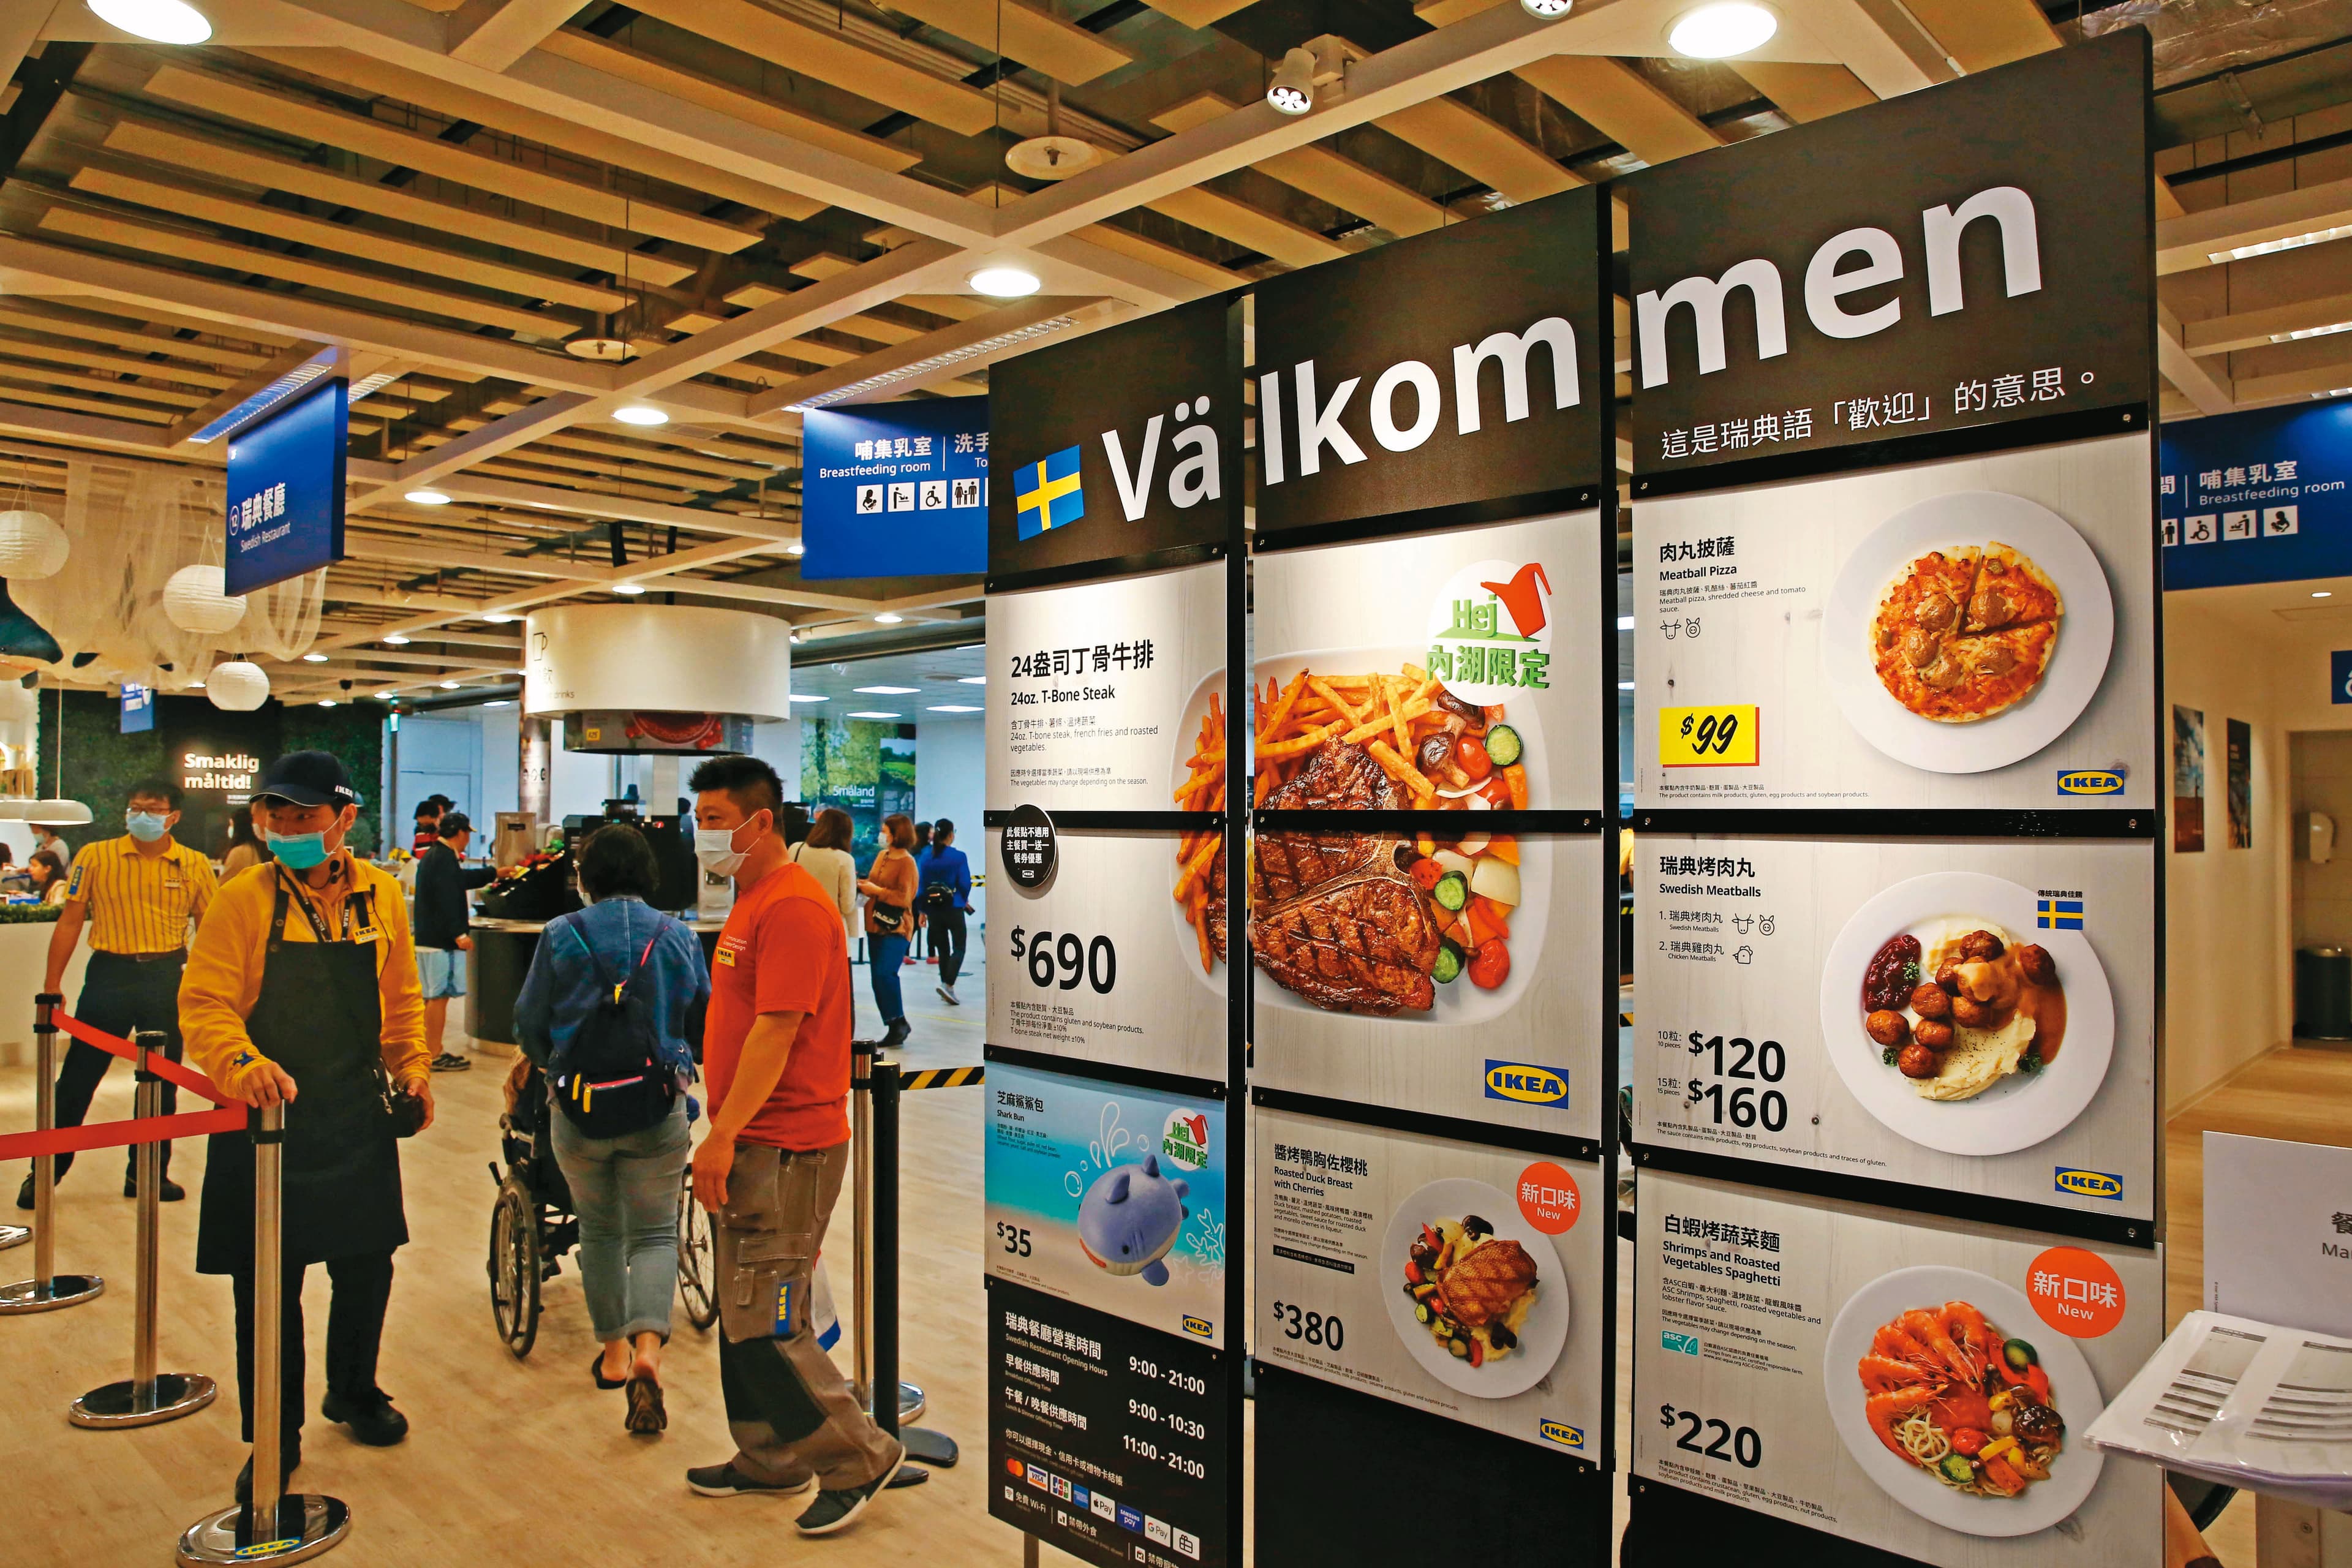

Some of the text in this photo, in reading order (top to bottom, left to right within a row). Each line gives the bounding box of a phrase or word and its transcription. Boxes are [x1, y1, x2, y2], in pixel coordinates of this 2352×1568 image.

[855, 436, 932, 461] 哺集乳室
[820, 462, 930, 478] Breastfeeding room
[975, 458, 987, 468] To
[2200, 461, 2297, 489] 哺集乳室
[2200, 481, 2344, 505] Breastfeeding room
[241, 482, 286, 531] 瑞典餐廳
[241, 522, 290, 552] Swedish Restaurant
[1660, 536, 1735, 563] 肉丸披薩
[1660, 565, 1736, 581] Meatball Pizza
[1659, 596, 1686, 605] Meatball
[1688, 595, 1706, 604] pizza,
[1708, 591, 1739, 600] shredded
[1453, 594, 1497, 637] Hej
[1012, 639, 1153, 677] 24盎司丁骨牛排
[1011, 684, 1115, 705] 24oz. T-Bone Steak
[1010, 725, 1158, 741] 24oz. T-bone steak, french fries and roasted
[1681, 713, 1738, 755] $99
[1011, 743, 1046, 753] vegetables.
[184, 753, 259, 773] Smaklig
[184, 772, 251, 789] måltid!
[335, 785, 353, 797] IKEA
[833, 785, 875, 796] Småland
[2065, 778, 2117, 787] IKEA
[1006, 826, 1049, 838] 此餐點不適用
[1007, 840, 1049, 851] 主餐買一送一
[1014, 853, 1042, 864] 餐券優惠
[1660, 856, 1755, 877] 瑞典烤肉丸
[1659, 883, 1761, 897] Swedish Meatballs
[1659, 911, 1723, 924] 1. 瑞典烤肉丸
[355, 927, 377, 937] IKEA
[1659, 941, 1724, 955] 2. 瑞典雞肉丸
[1011, 925, 1116, 994] $690
[1688, 1030, 1785, 1083] $120
[1493, 1071, 1561, 1096] IKEA
[997, 1090, 1044, 1112] 芝麻鯊鯊包
[1687, 1078, 1787, 1132] $160
[997, 1109, 1024, 1121] Shark Bun
[1172, 1122, 1189, 1142] Hej
[1275, 1144, 1367, 1177] 醬烤鴨胸佐櫻桃
[1273, 1179, 1324, 1196] with Cherries
[1274, 1166, 1352, 1189] Roasted Duck Breast
[2062, 1175, 2116, 1192] IKEA
[1521, 1182, 1575, 1210] 新口味
[1537, 1207, 1561, 1221] New
[997, 1221, 1031, 1258] $35
[1664, 1214, 1780, 1253] 白蝦烤蔬菜麵
[1662, 1240, 1780, 1272] Shrimps and Roasted
[1662, 1254, 1780, 1286] Vegetables Spaghetti
[2034, 1270, 2117, 1308] 新口味
[778, 1286, 787, 1320] IKEA
[1662, 1292, 1727, 1313] lobster flavor sauce.
[1662, 1285, 1675, 1295] ASC
[1676, 1288, 1704, 1300] Shrimps,
[1706, 1295, 1738, 1308] spaghetti,
[1740, 1303, 1766, 1313] roasted
[1768, 1308, 1806, 1321] vegetables
[2058, 1302, 2094, 1321] New
[1005, 1311, 1101, 1360] 瑞典餐廳營業時間
[1186, 1319, 1210, 1334] IKEA
[1273, 1300, 1344, 1351] $380
[1664, 1331, 1682, 1341] asc
[1005, 1333, 1107, 1376] Swedish Restaurant Opening Hours
[1005, 1353, 1059, 1385] 早餐供應時間
[1129, 1355, 1157, 1378] 9:00
[1169, 1370, 1205, 1395] 21:00
[1005, 1385, 1023, 1404] 午餐
[1031, 1396, 1086, 1430] 晚餐供應時間
[1129, 1398, 1156, 1421] 9:00
[1168, 1414, 1204, 1439] 10:30
[1545, 1424, 1580, 1444] IKEA
[1660, 1403, 1762, 1468] $220
[1005, 1428, 1123, 1487] 你可以選擇現金、信用卡或禮物卡結帳
[1123, 1434, 1156, 1460] 11:00
[1168, 1452, 1204, 1479] 21:00
[1030, 1472, 1044, 1483] VISA
[1052, 1480, 1068, 1495] JCB
[1016, 1491, 1028, 1506] 免費
[1030, 1498, 1046, 1513] Wi-Fi
[1099, 1501, 1113, 1515] Pay
[1120, 1509, 1140, 1521] SAMSUNG
[1124, 1517, 1136, 1527] pay
[1069, 1515, 1097, 1537] 禁帶外食
[242, 1540, 293, 1553] IKEA
